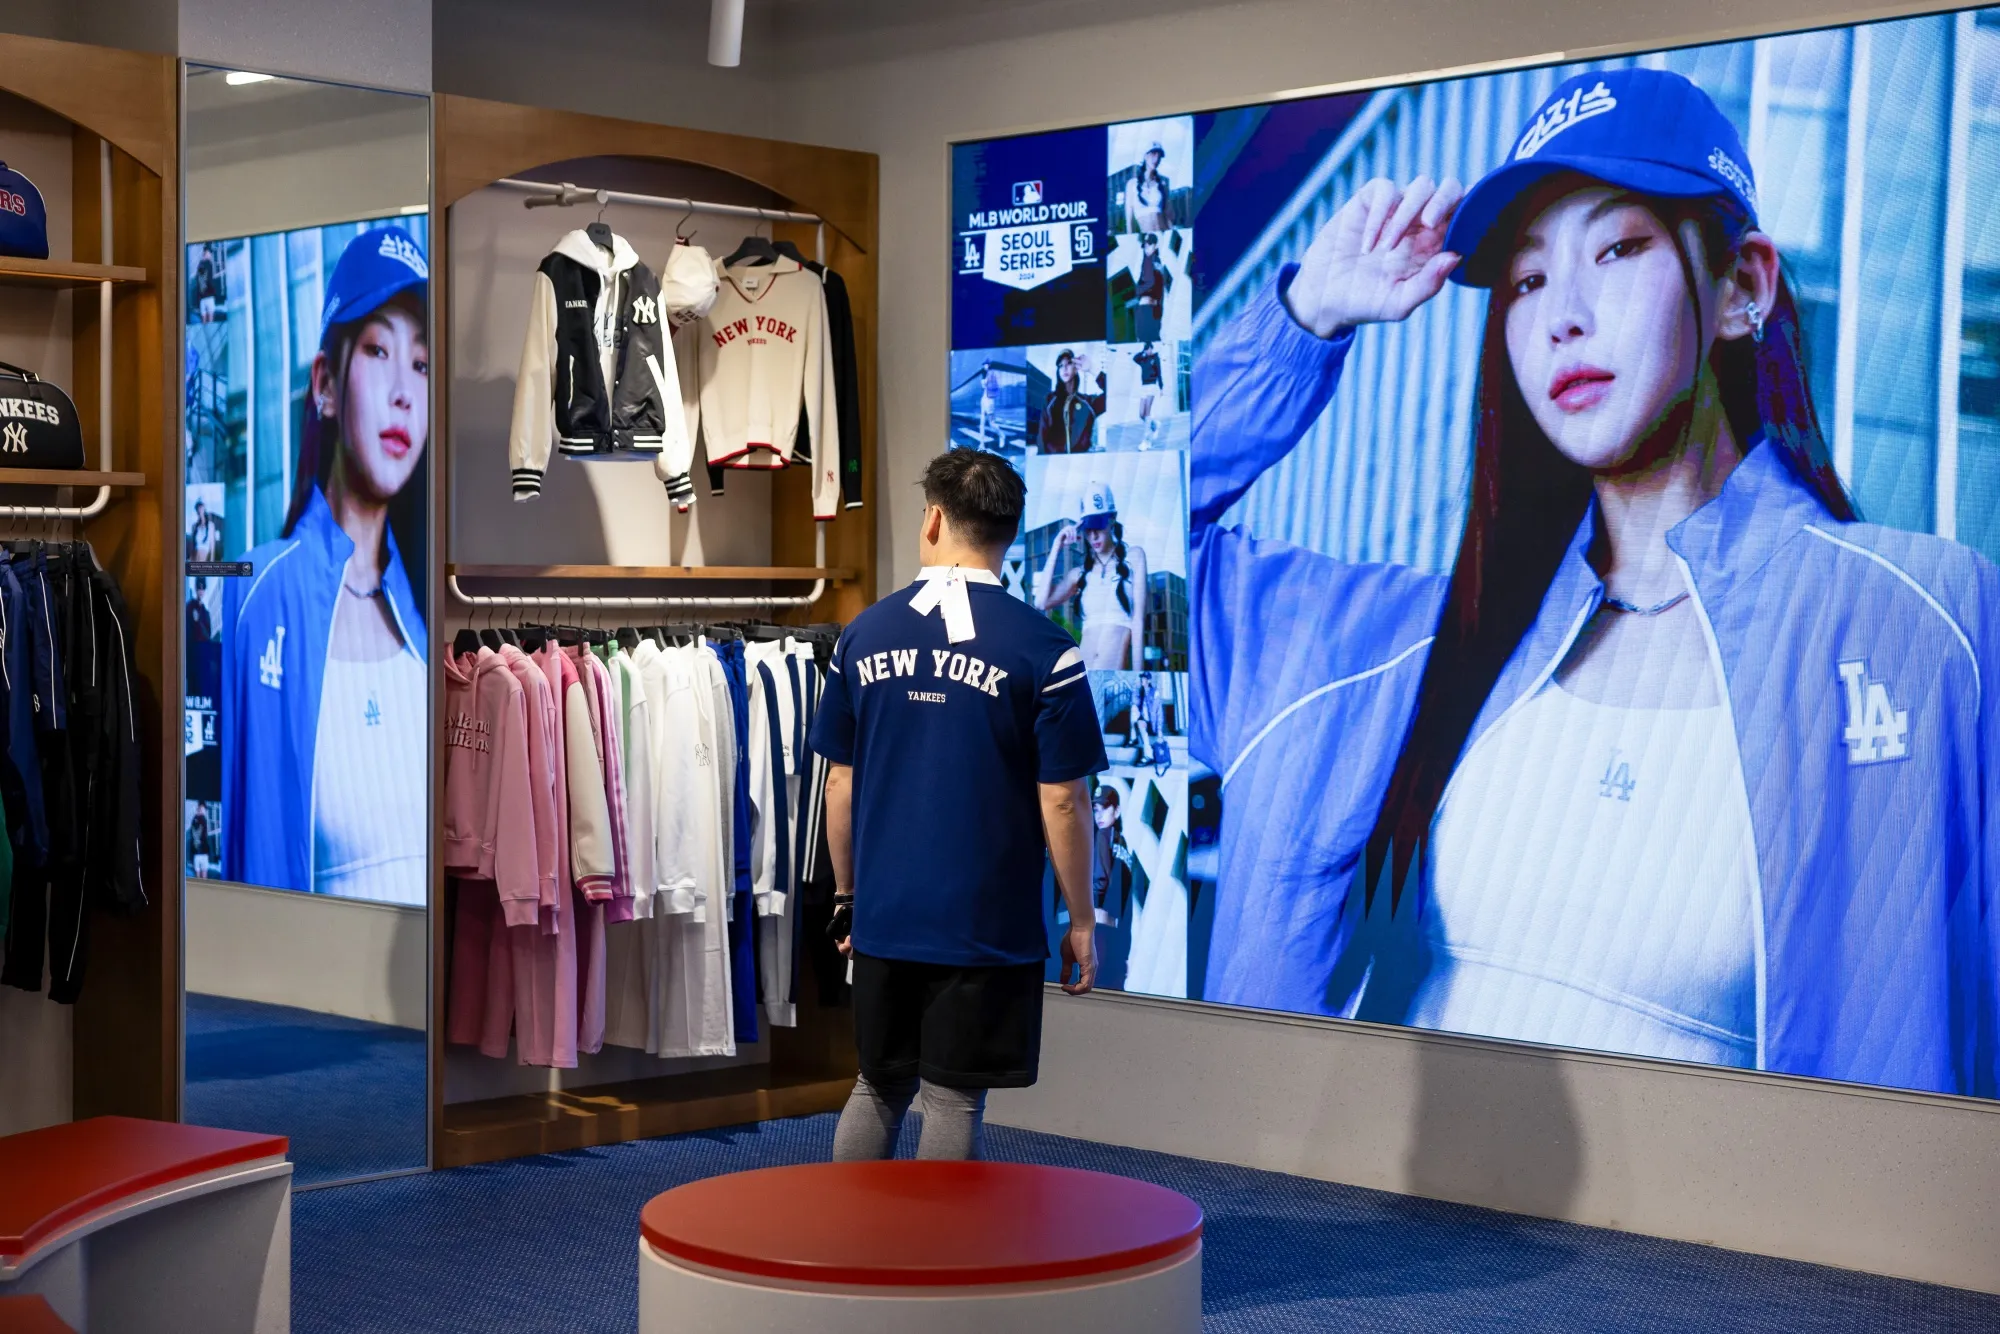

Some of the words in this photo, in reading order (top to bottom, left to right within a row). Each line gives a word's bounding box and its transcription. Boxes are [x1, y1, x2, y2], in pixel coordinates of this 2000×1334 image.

[969, 211, 1000, 229] MLB
[1000, 205, 1051, 226] WORLD
[1051, 201, 1088, 220] TOUR
[964, 237, 981, 268] LA
[1001, 231, 1054, 251] SEOUL
[1075, 226, 1093, 257] SD
[1000, 251, 1055, 271] SERIES
[632, 295, 657, 324] NY
[712, 318, 749, 348] NEW
[756, 316, 797, 343] YORK
[2, 421, 28, 453] NY
[856, 648, 918, 687] NEW
[932, 649, 1008, 698] YORK
[907, 690, 946, 703] YANKEES
[1838, 659, 1909, 765] LA
[1600, 748, 1636, 801] LA
